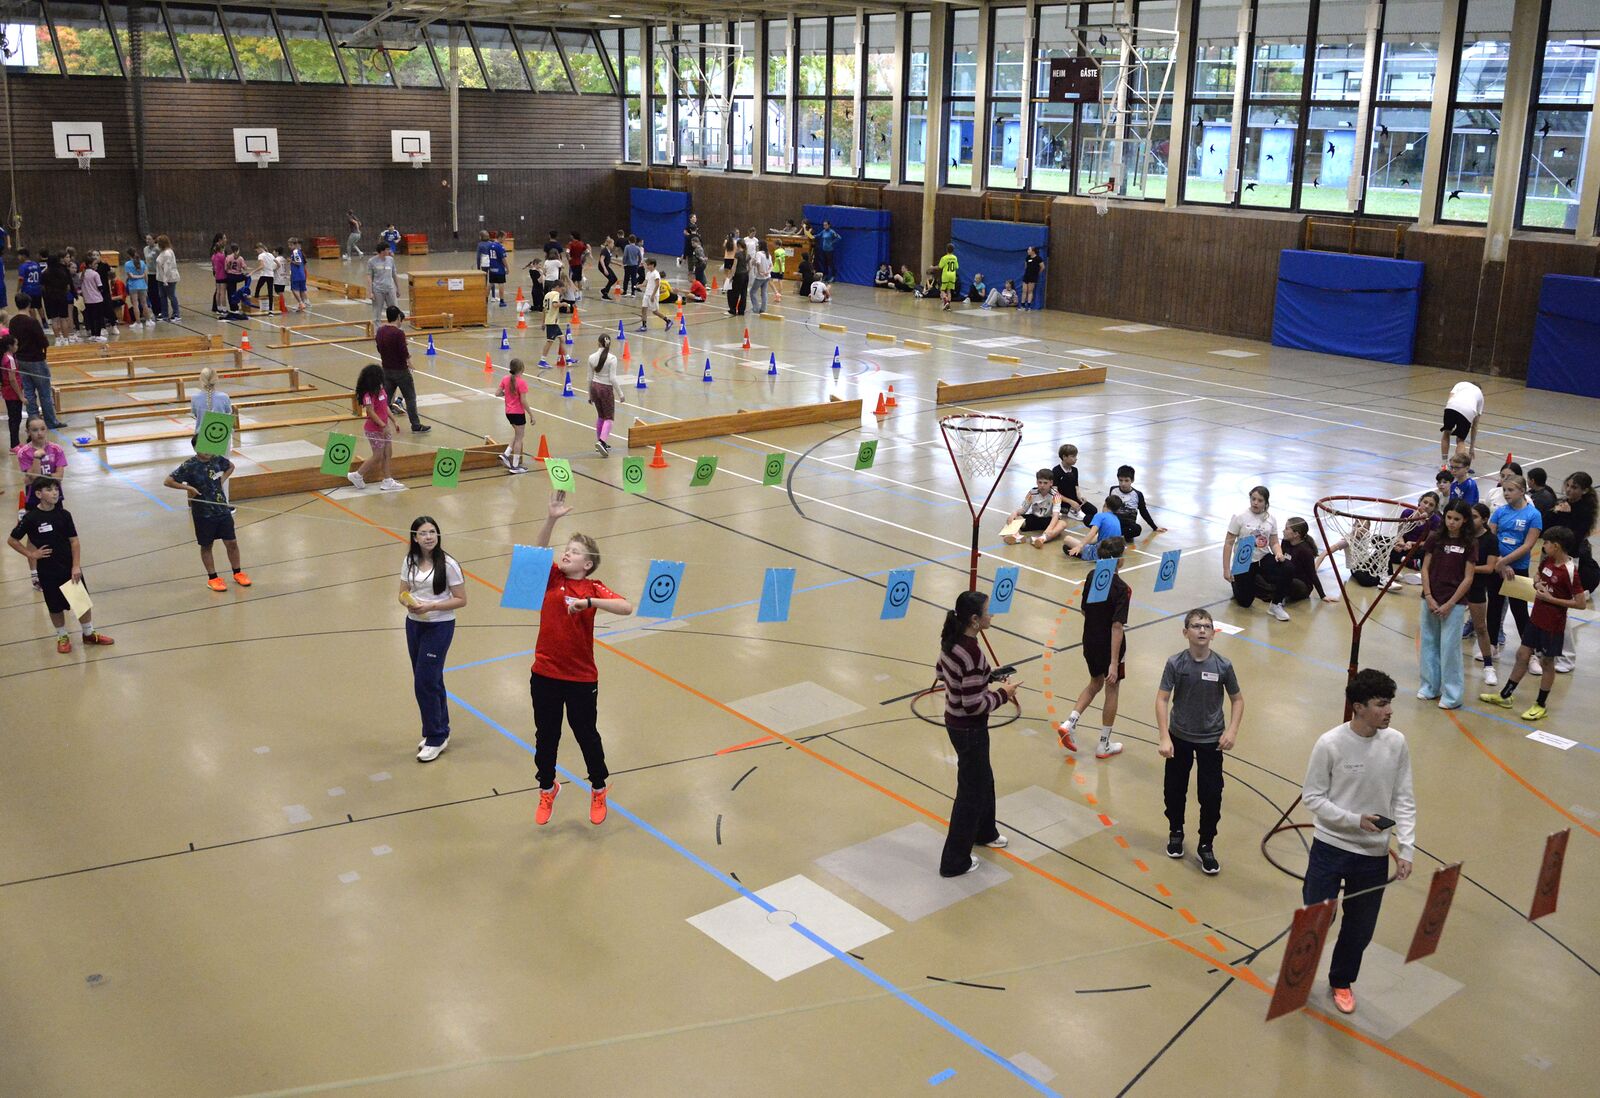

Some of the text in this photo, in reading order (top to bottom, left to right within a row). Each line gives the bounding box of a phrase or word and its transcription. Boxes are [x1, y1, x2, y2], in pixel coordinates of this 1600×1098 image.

[1052, 67, 1098, 77] HEIM GÄSTE
[947, 261, 955, 272] 10
[27, 271, 39, 283] 20
[812, 286, 818, 296] 7
[40, 464, 52, 475] 12
